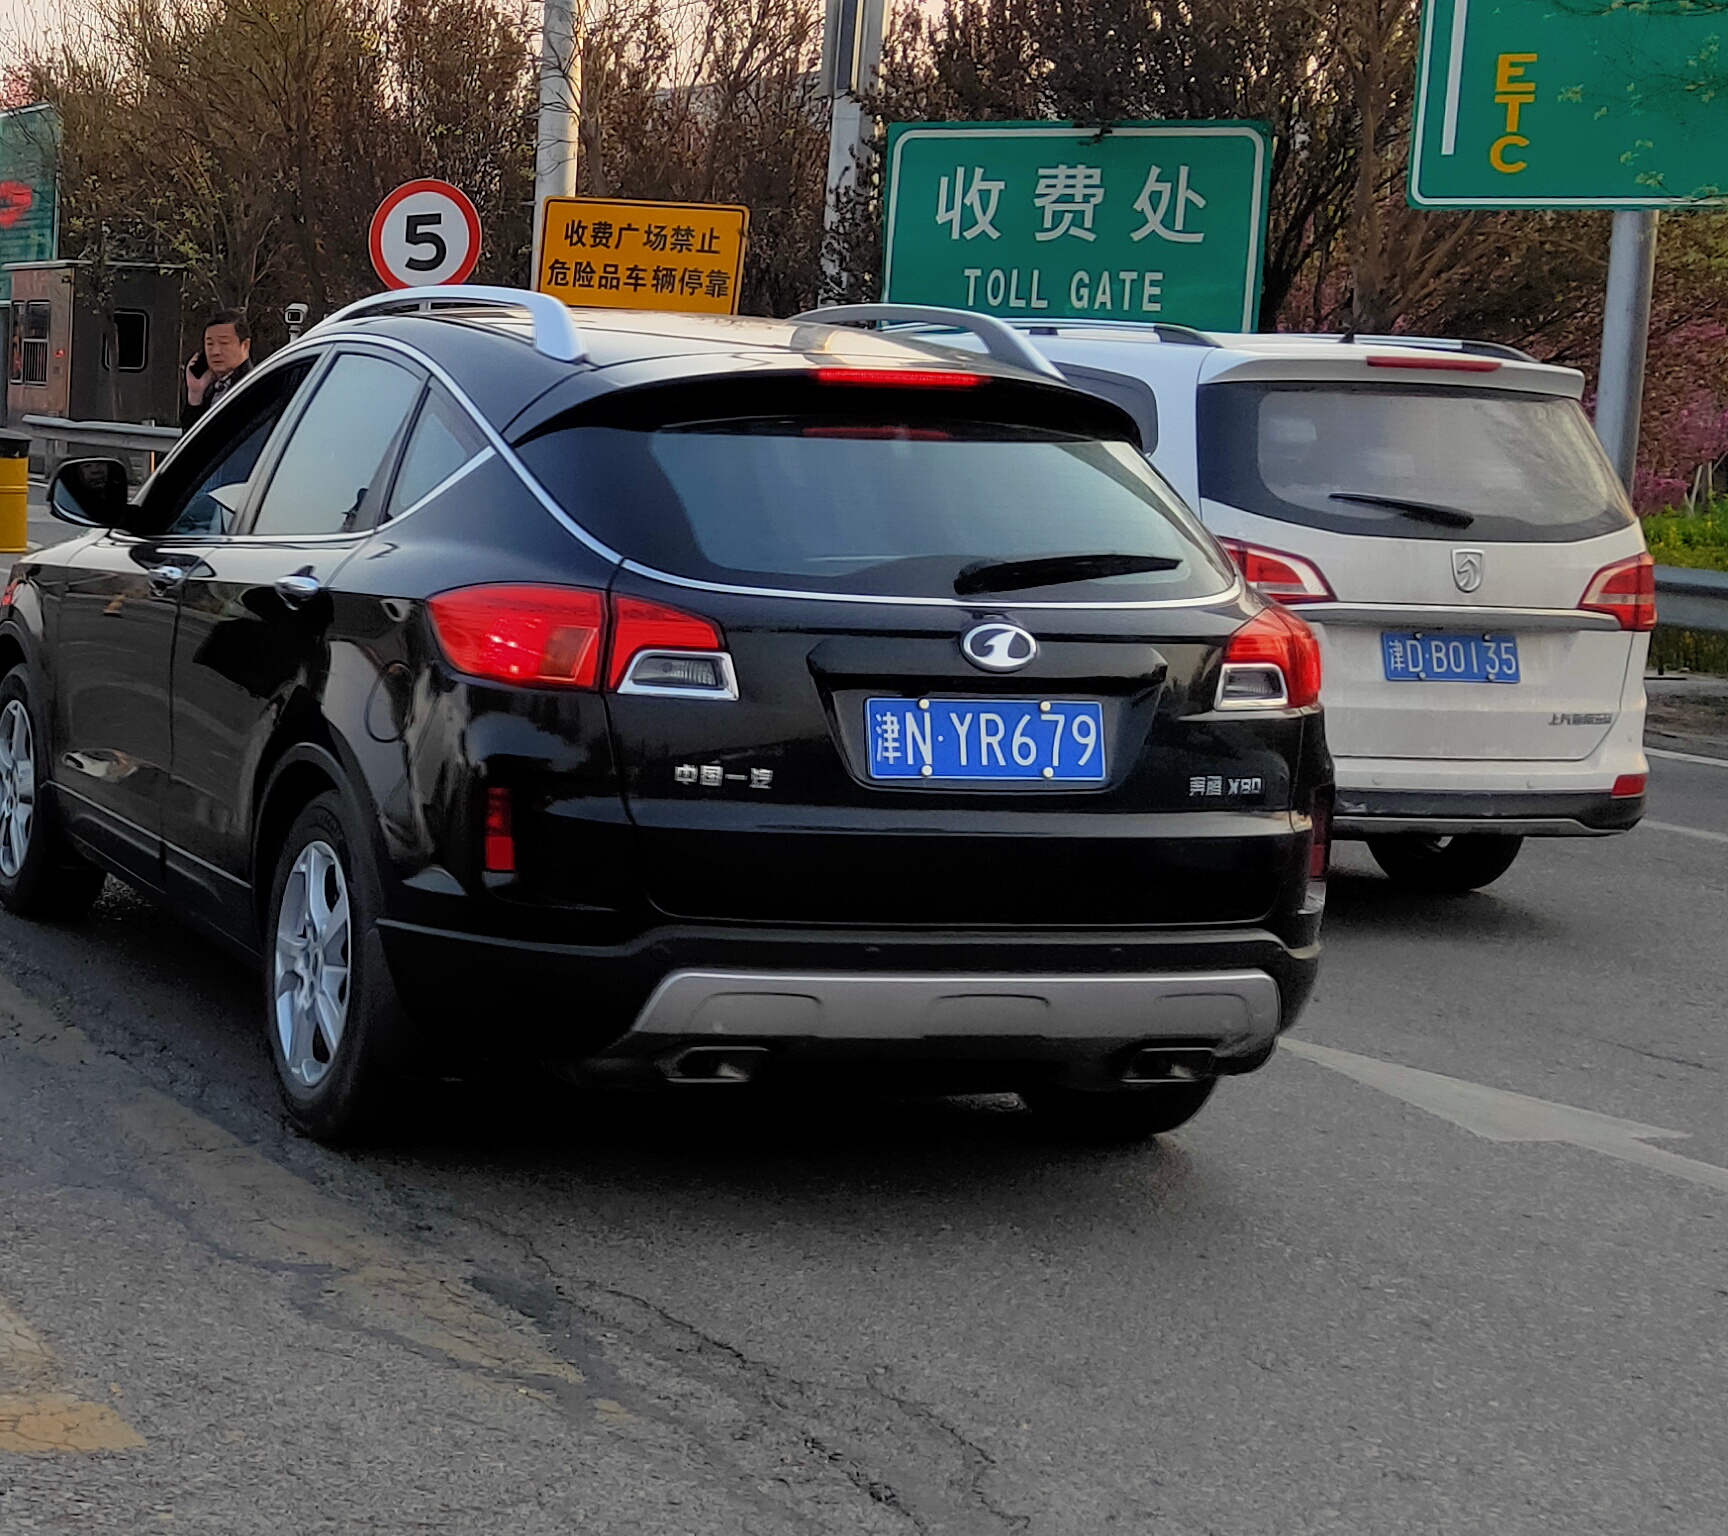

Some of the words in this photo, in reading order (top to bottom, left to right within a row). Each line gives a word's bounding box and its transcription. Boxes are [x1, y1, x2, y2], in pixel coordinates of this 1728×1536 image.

[1489, 53, 1538, 173] ETC
[935, 164, 1207, 243] 收费处
[405, 213, 447, 271] 5
[563, 219, 721, 255] 收费广场禁止
[546, 258, 731, 298] 危险品车辆停靠
[963, 268, 1048, 309] TOLL
[1070, 270, 1164, 311] GATE
[875, 711, 1098, 767] 津N·YR679
[674, 763, 774, 790] 中国一汽
[1227, 777, 1262, 795] X80
